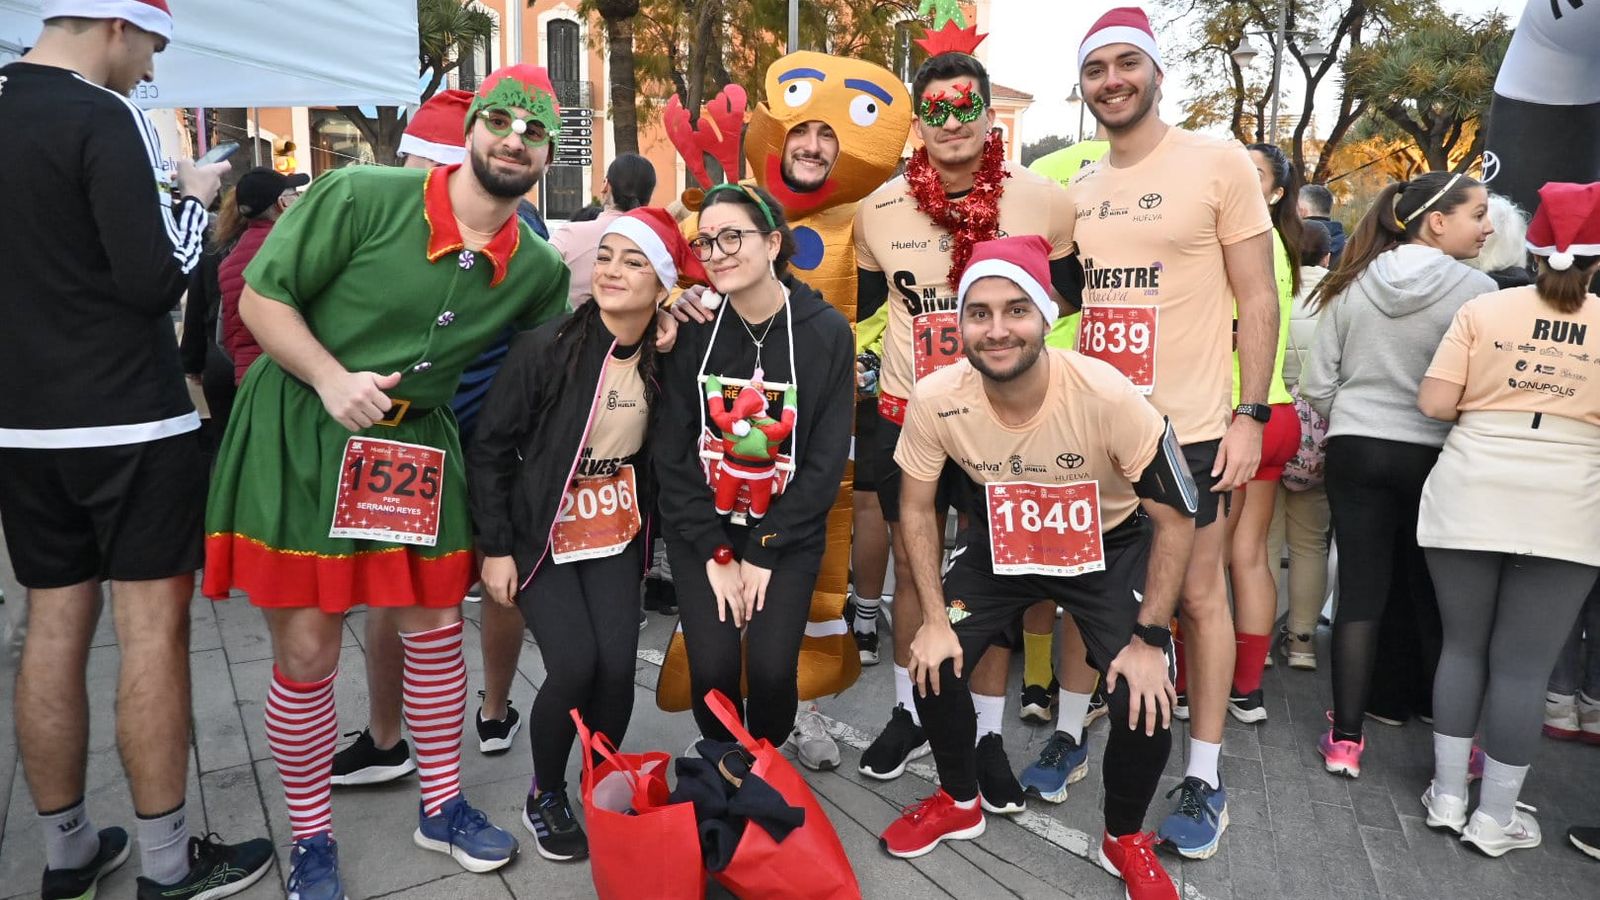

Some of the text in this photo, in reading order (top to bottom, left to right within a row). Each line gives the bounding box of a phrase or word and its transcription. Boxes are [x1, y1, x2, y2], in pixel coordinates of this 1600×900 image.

[892, 240, 927, 249] Huelva
[1083, 321, 1150, 354] 1839
[1532, 319, 1587, 346] RUN
[1518, 381, 1576, 397] ONUPOLIS
[349, 456, 438, 499] 1525
[961, 457, 999, 472] Huelva
[1055, 472, 1090, 482] HUELVA
[357, 502, 421, 516] SERRANO REYES
[560, 480, 632, 522] 2096
[996, 499, 1093, 535] 1840
